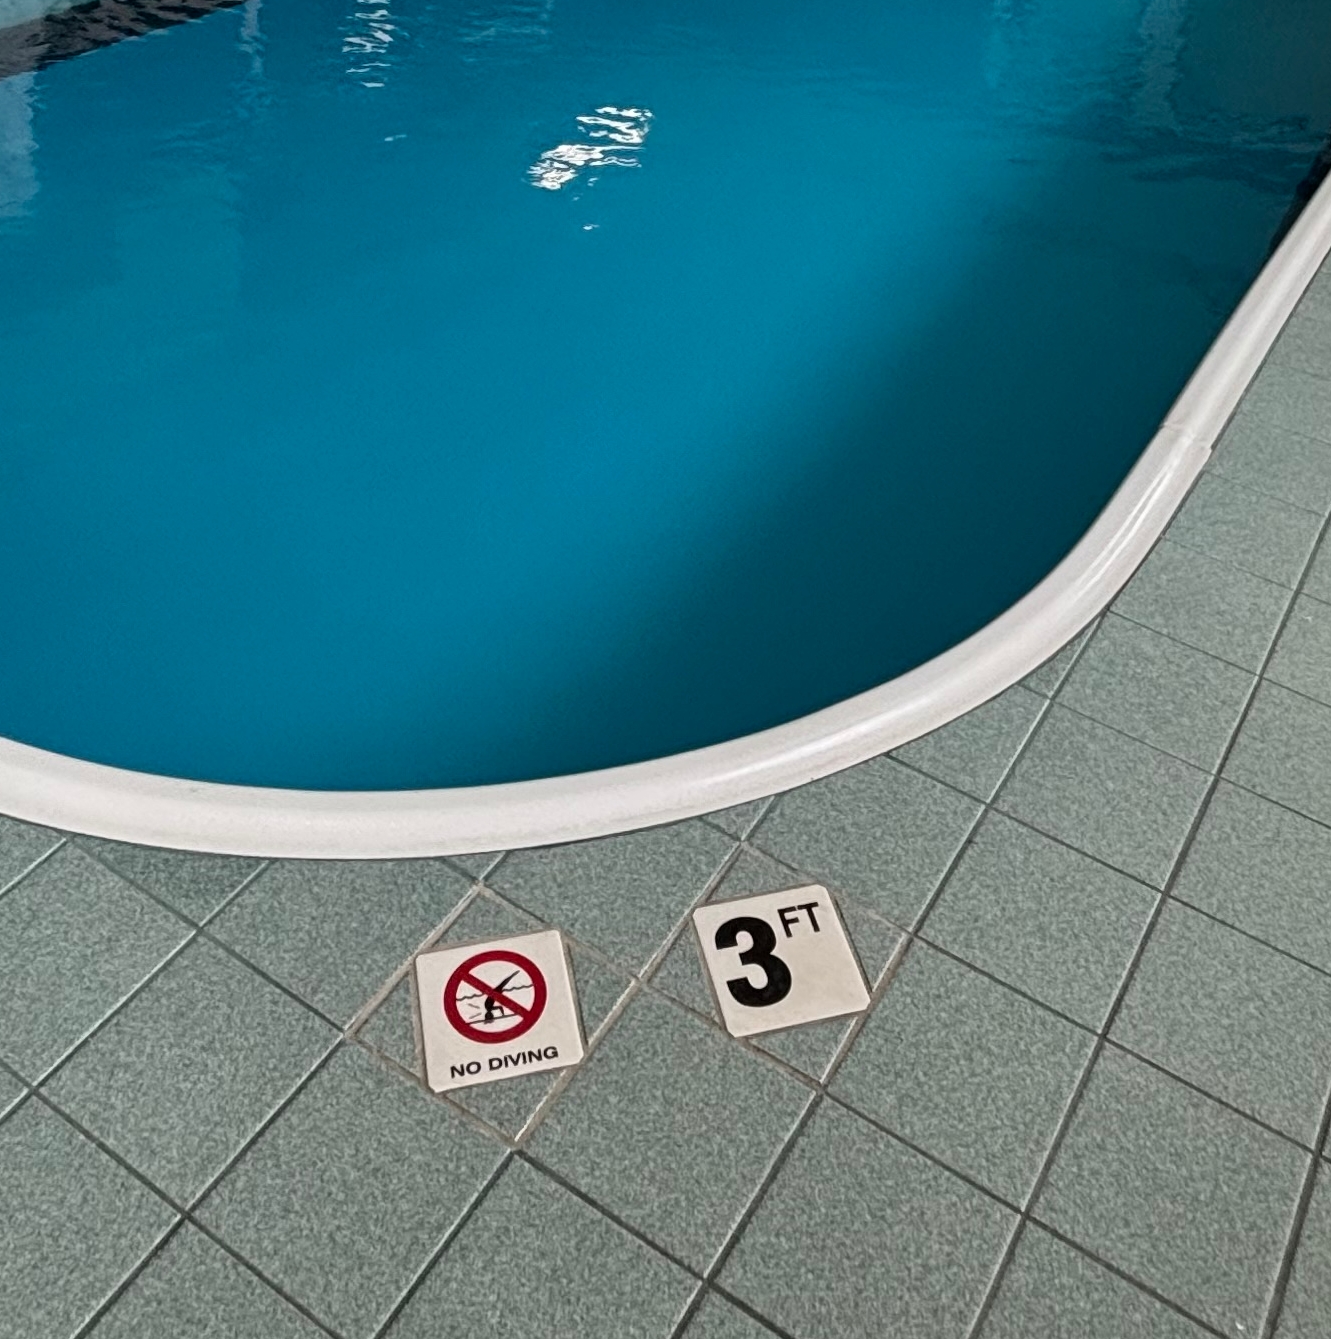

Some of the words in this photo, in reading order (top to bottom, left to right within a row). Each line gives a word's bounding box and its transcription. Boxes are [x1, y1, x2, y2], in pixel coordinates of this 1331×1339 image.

[714, 915, 792, 1008] 3
[777, 901, 821, 938] FT
[449, 1060, 483, 1079] NO
[488, 1045, 559, 1072] DIVING
